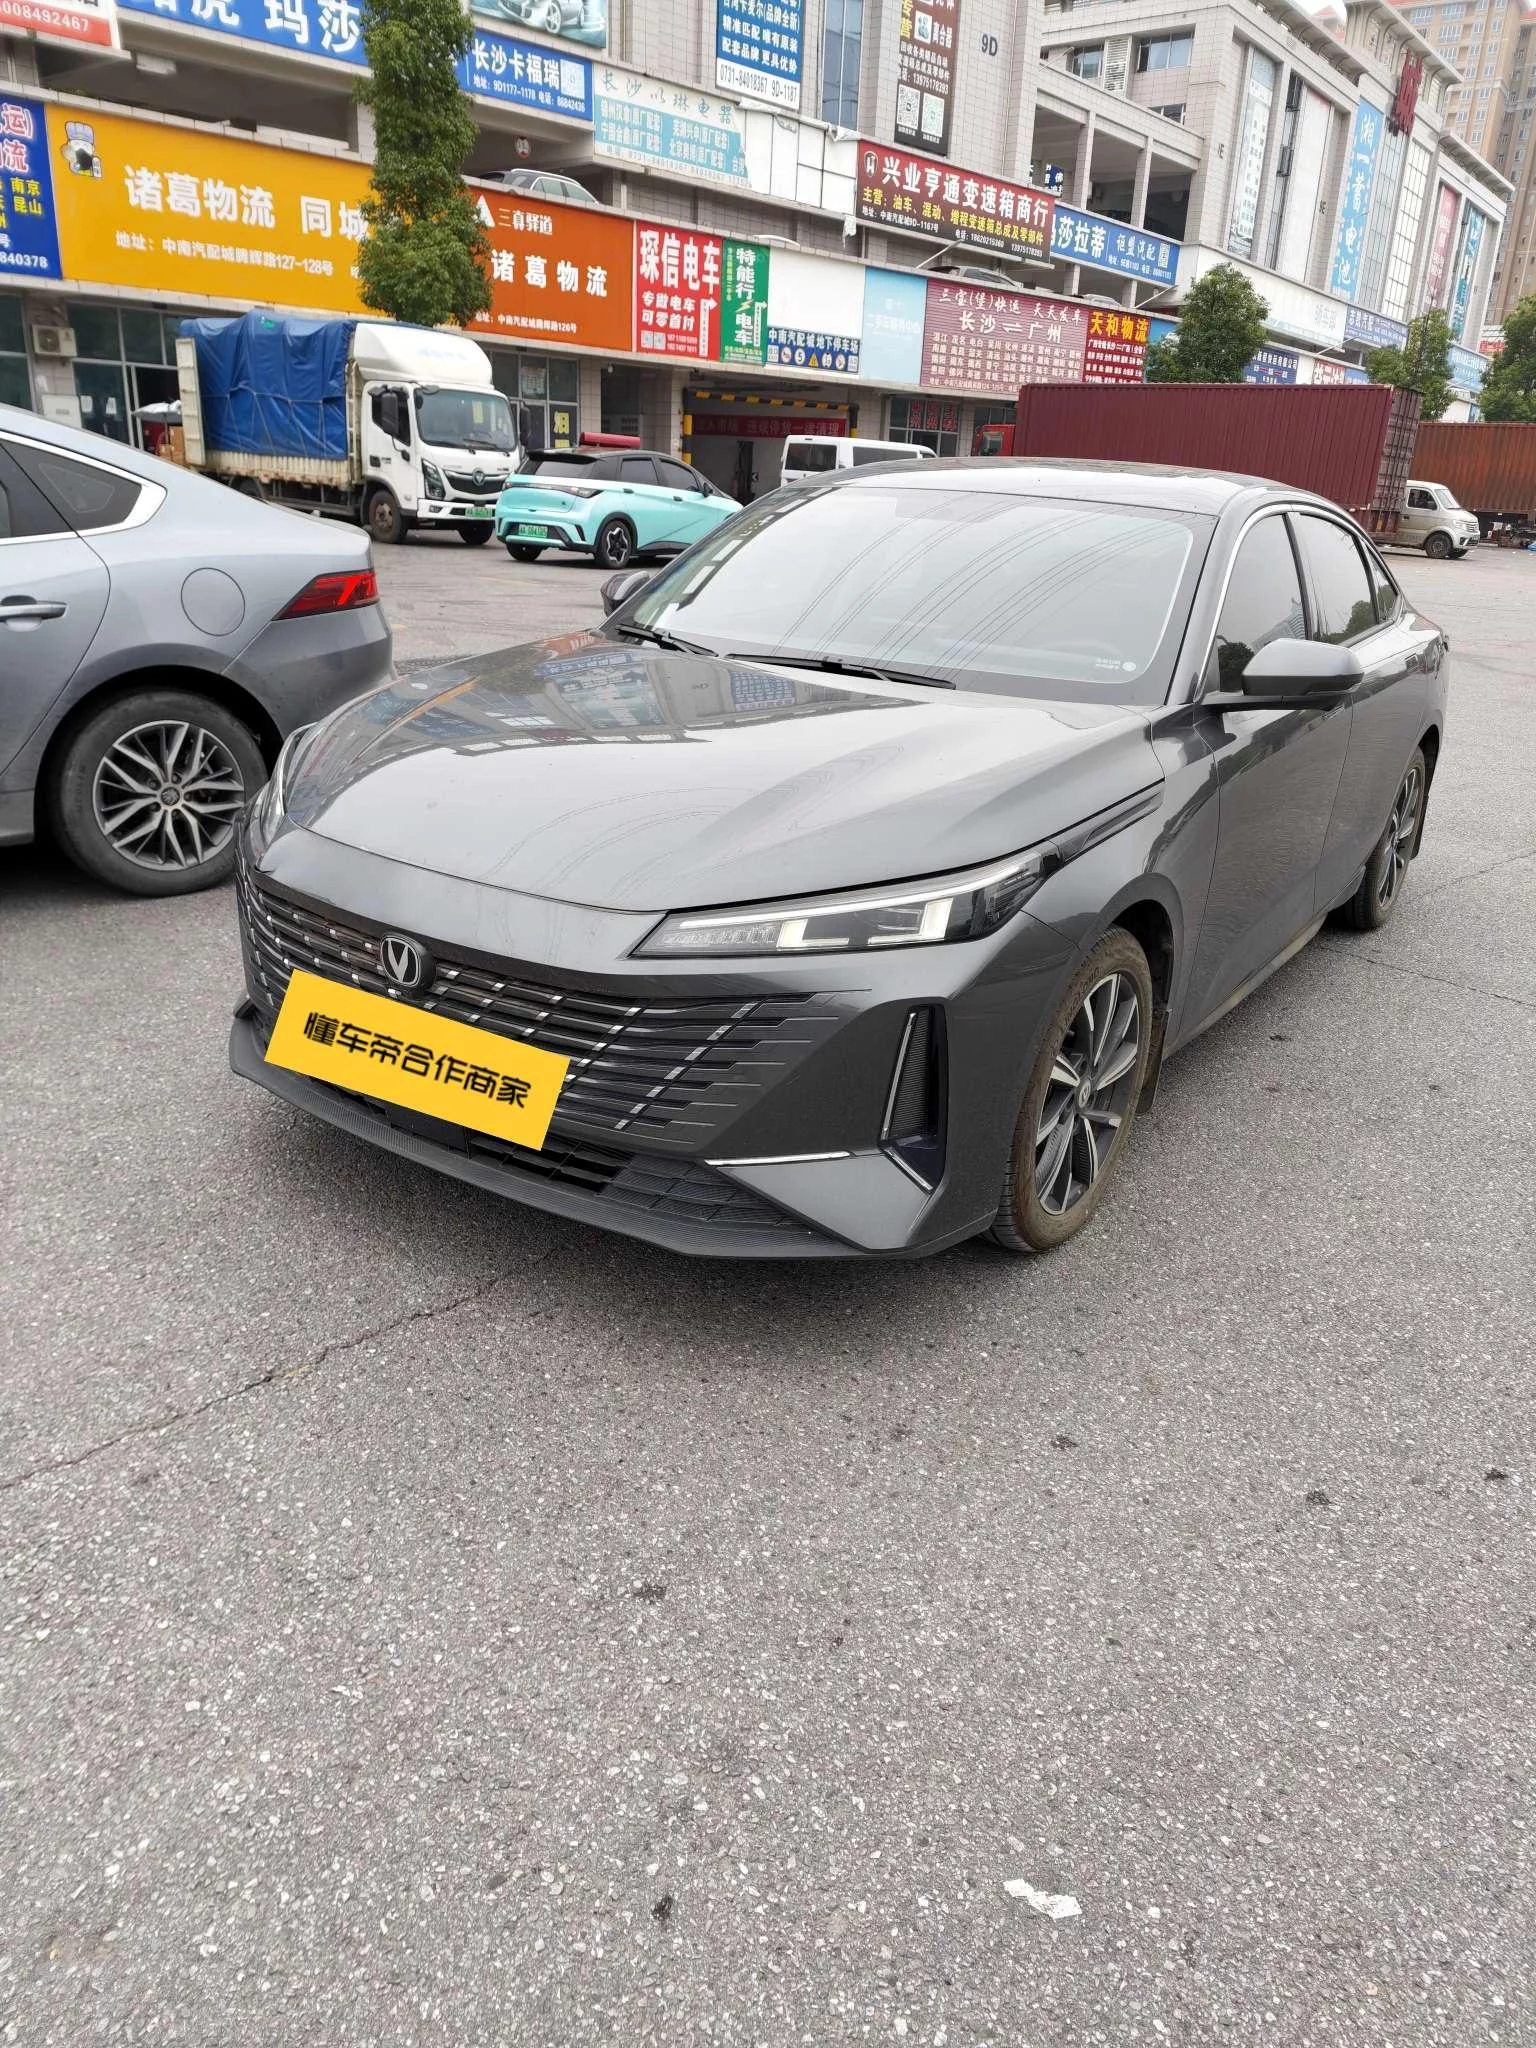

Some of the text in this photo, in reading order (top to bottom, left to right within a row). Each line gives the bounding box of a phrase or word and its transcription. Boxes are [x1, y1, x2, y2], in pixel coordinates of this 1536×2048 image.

[0, 1, 90, 32] 008492467
[722, 14, 760, 41] 精准匹配
[932, 21, 953, 48] 离合器
[981, 33, 998, 57] 9D
[472, 37, 560, 91] 长沙卡福瑞
[721, 36, 798, 75] 配套品牌 更具优势
[10, 177, 41, 197] 南京
[123, 163, 277, 230] 诸葛物流
[882, 155, 1049, 229] 兴业亨通变速箱商行
[13, 196, 43, 217] 昆山
[1050, 211, 1107, 259] 莎拉蒂
[490, 248, 608, 298] 诸葛物流
[639, 229, 721, 296] 琛信电车
[735, 248, 756, 301] 特能行
[641, 308, 697, 334] 可零首付
[938, 288, 1083, 327] 三宝(堡)快运 天天发车
[734, 312, 755, 346] 电车
[768, 328, 859, 355] 中南汽配城地下停车场
[959, 310, 1063, 344] 长沙 广州
[1089, 311, 1149, 343] 天和物流
